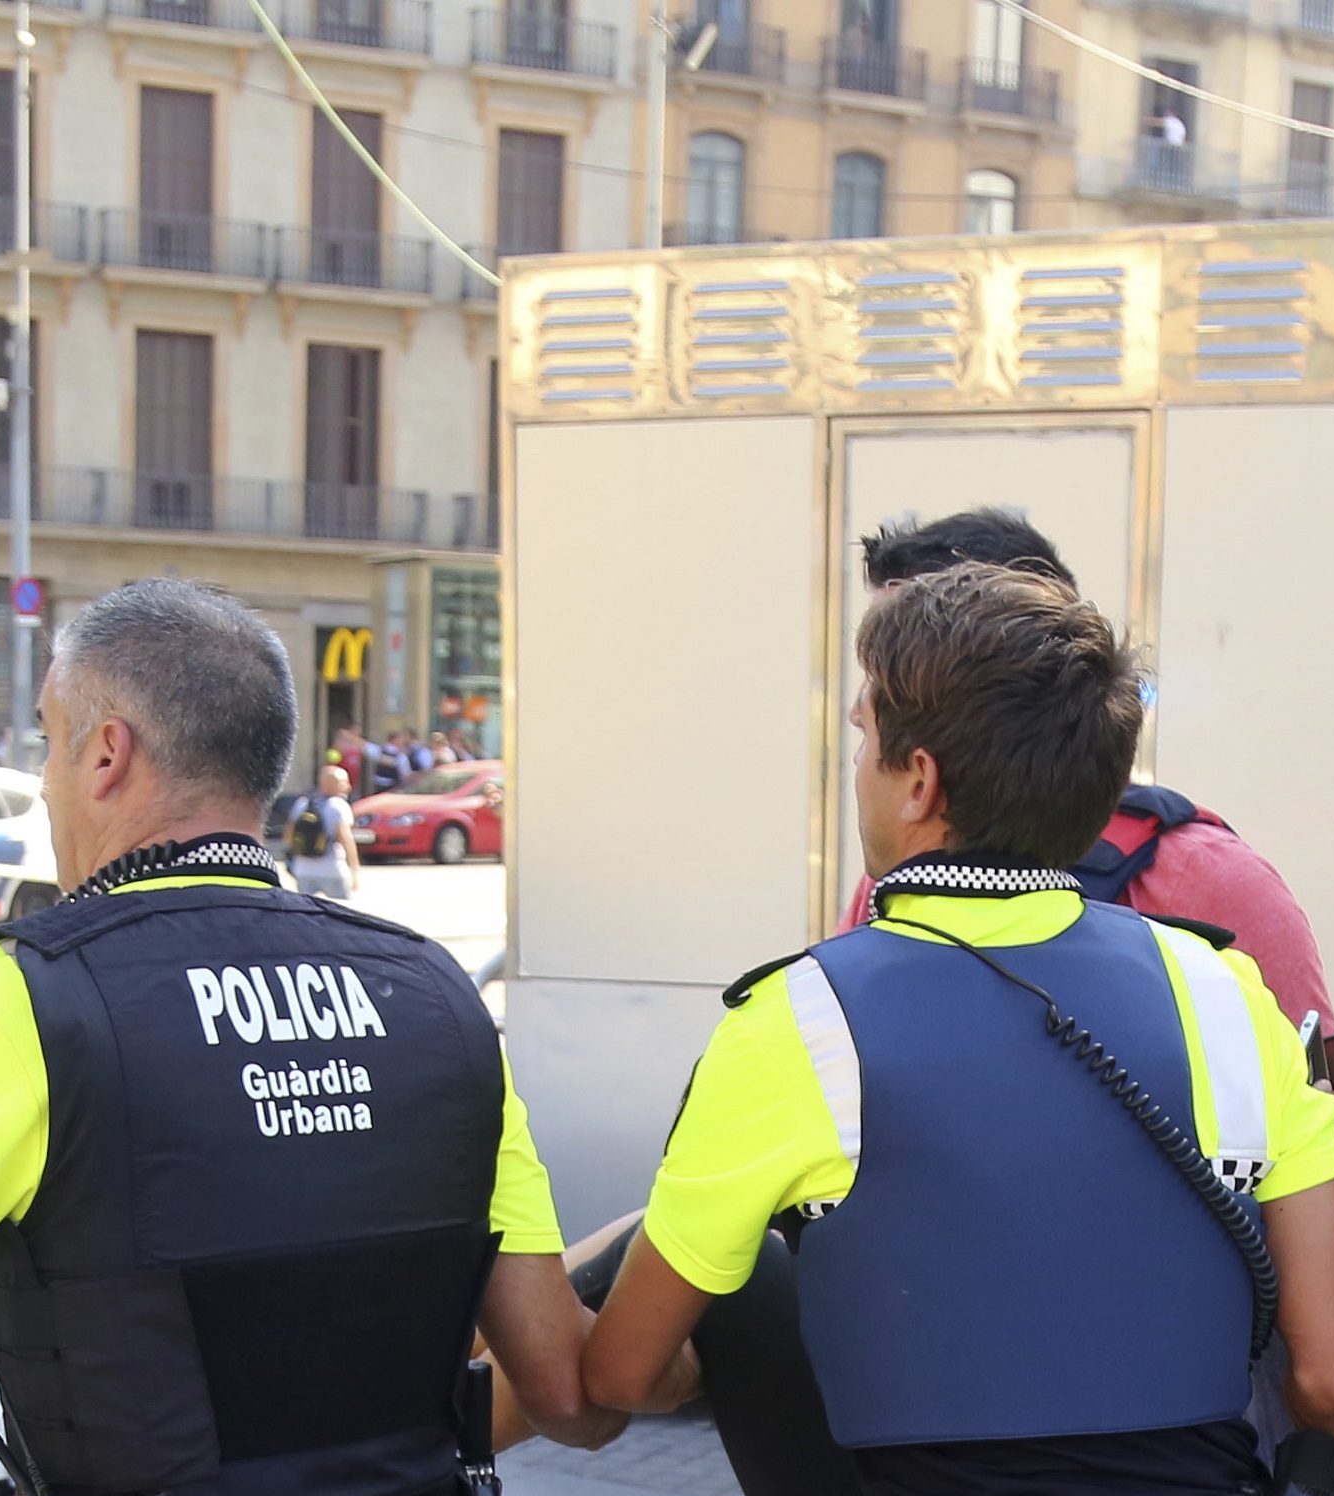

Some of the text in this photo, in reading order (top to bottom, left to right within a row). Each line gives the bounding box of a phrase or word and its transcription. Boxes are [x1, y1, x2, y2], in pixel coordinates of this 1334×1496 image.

[186, 963, 387, 1045] POLICIA
[241, 1059, 372, 1100] Guàrdia
[254, 1100, 373, 1138] Urbana
